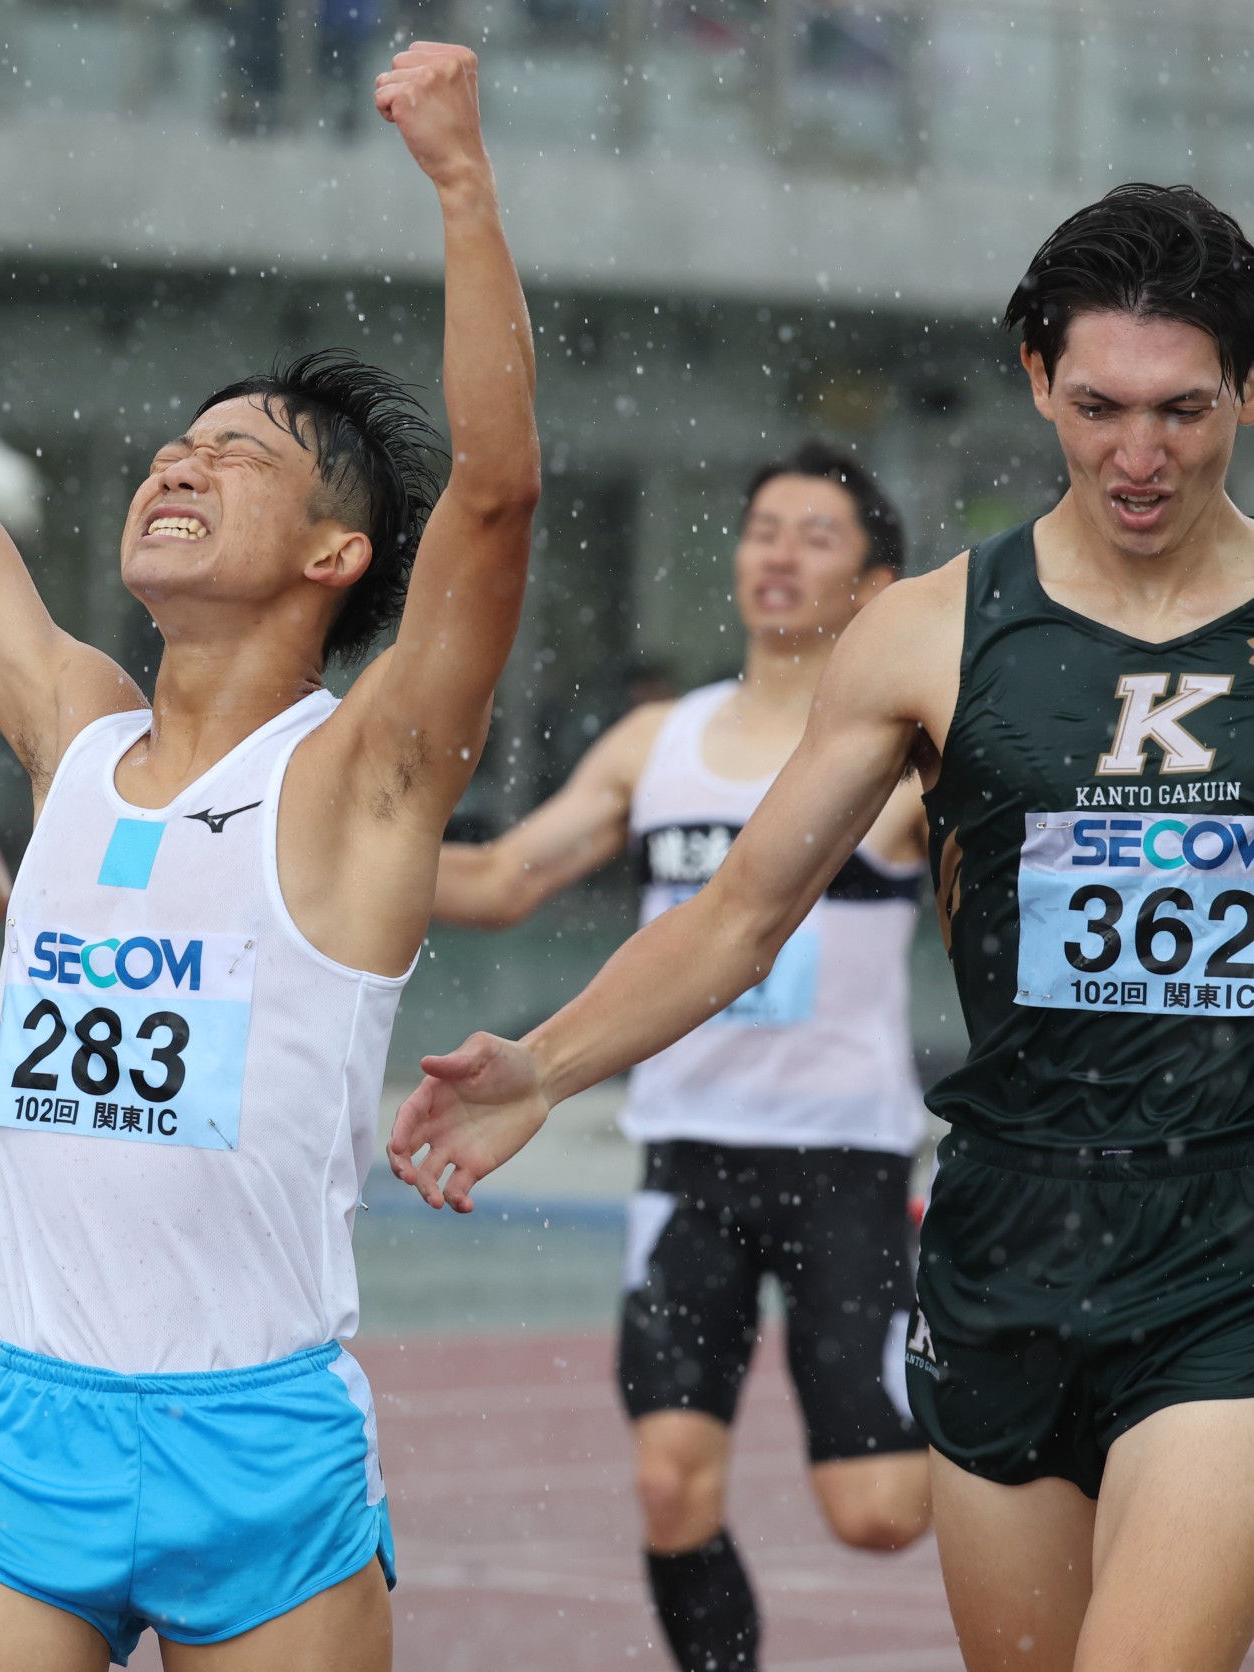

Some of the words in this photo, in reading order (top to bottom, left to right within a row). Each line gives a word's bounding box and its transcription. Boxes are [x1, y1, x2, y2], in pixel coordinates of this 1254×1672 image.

[1094, 672, 1235, 776] K
[1075, 785, 1152, 807] KANTO
[1158, 781, 1242, 805] GAKUIN
[28, 931, 203, 991] SECOM
[1063, 884, 1254, 979] 362
[1070, 980, 1147, 1006] 102回
[1163, 982, 1254, 1010] 関東IC
[11, 998, 190, 1102] 283
[14, 1095, 79, 1125] 102回
[92, 1102, 178, 1136] 関東IC
